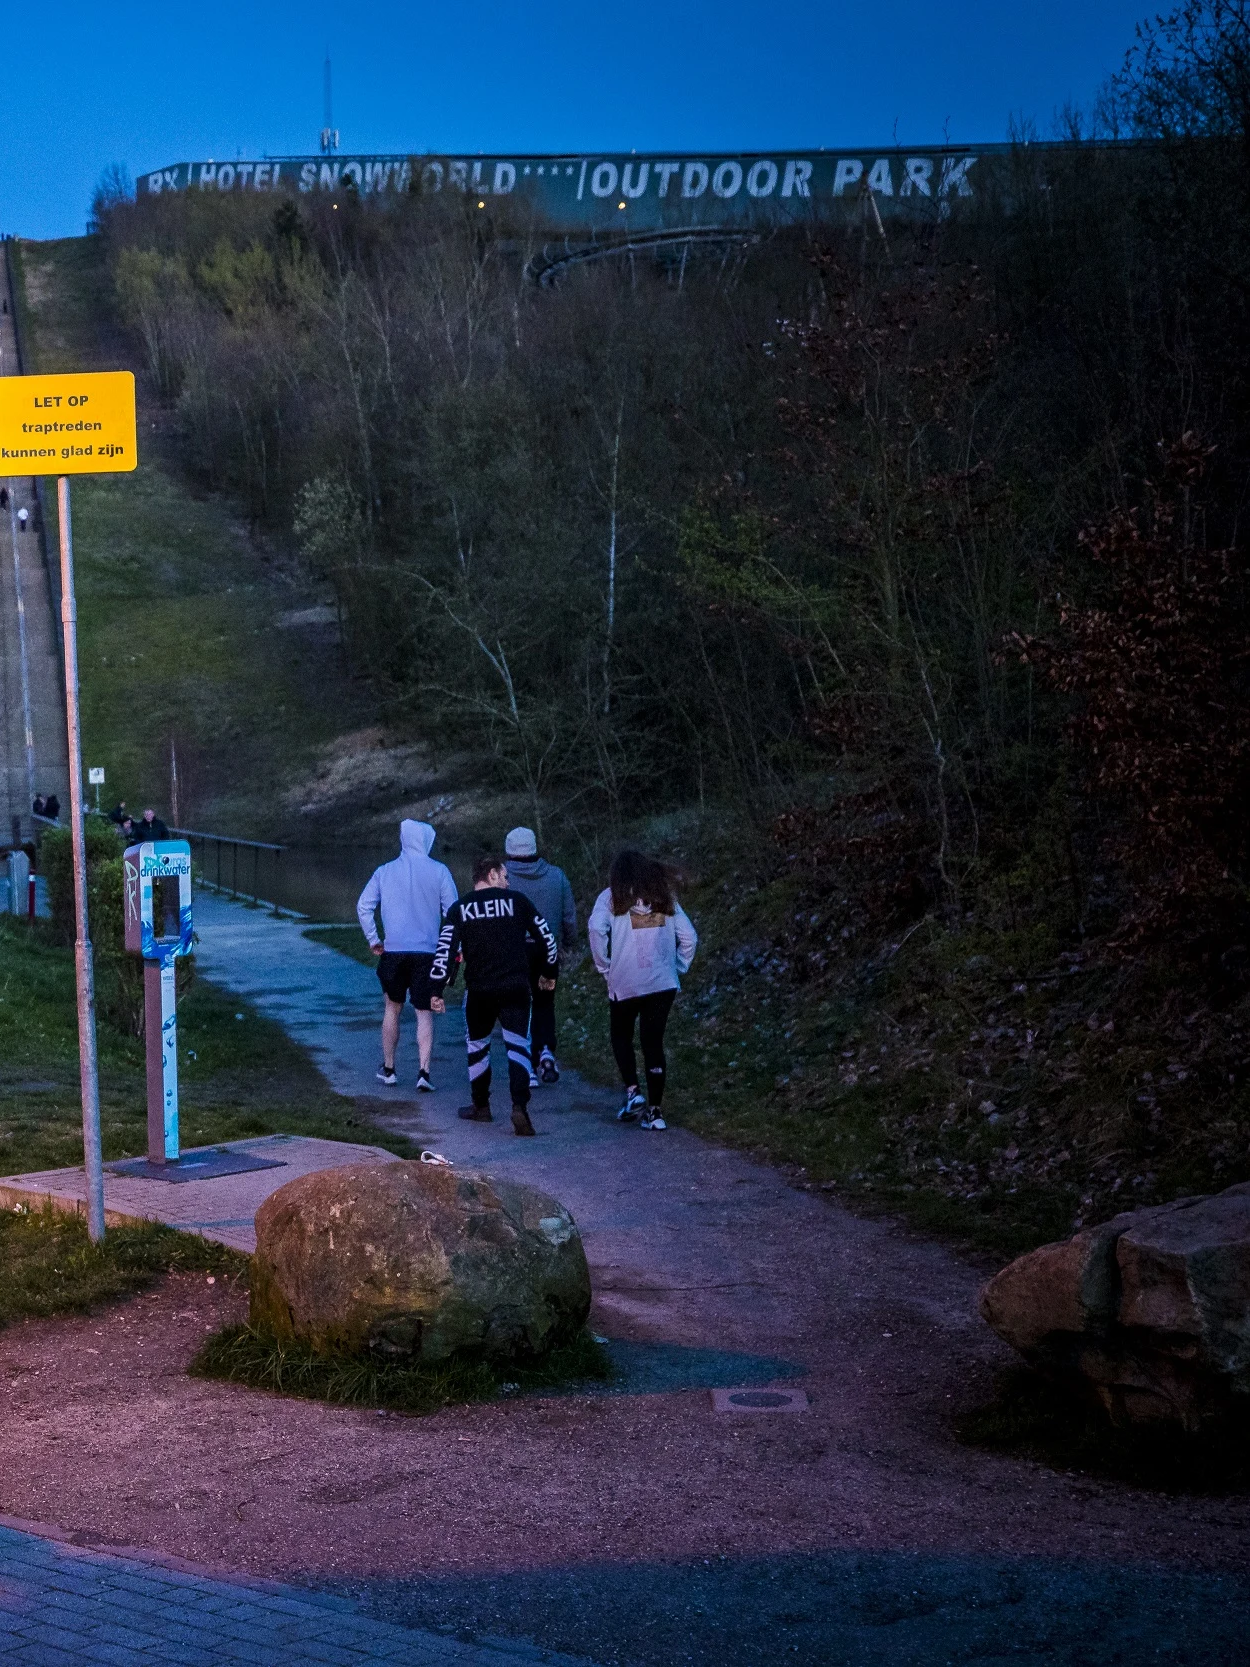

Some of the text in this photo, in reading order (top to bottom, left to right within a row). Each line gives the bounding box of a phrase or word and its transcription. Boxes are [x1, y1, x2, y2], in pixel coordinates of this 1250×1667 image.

[590, 159, 814, 199] OUTDOOR
[833, 156, 979, 198] PARK
[34, 395, 89, 408] LET OP
[22, 420, 102, 435] traptreden
[1, 444, 124, 458] kunnen glad zijn
[140, 863, 191, 877] drinkwater
[460, 898, 514, 922] KLEIN
[429, 924, 455, 980] CALVIN
